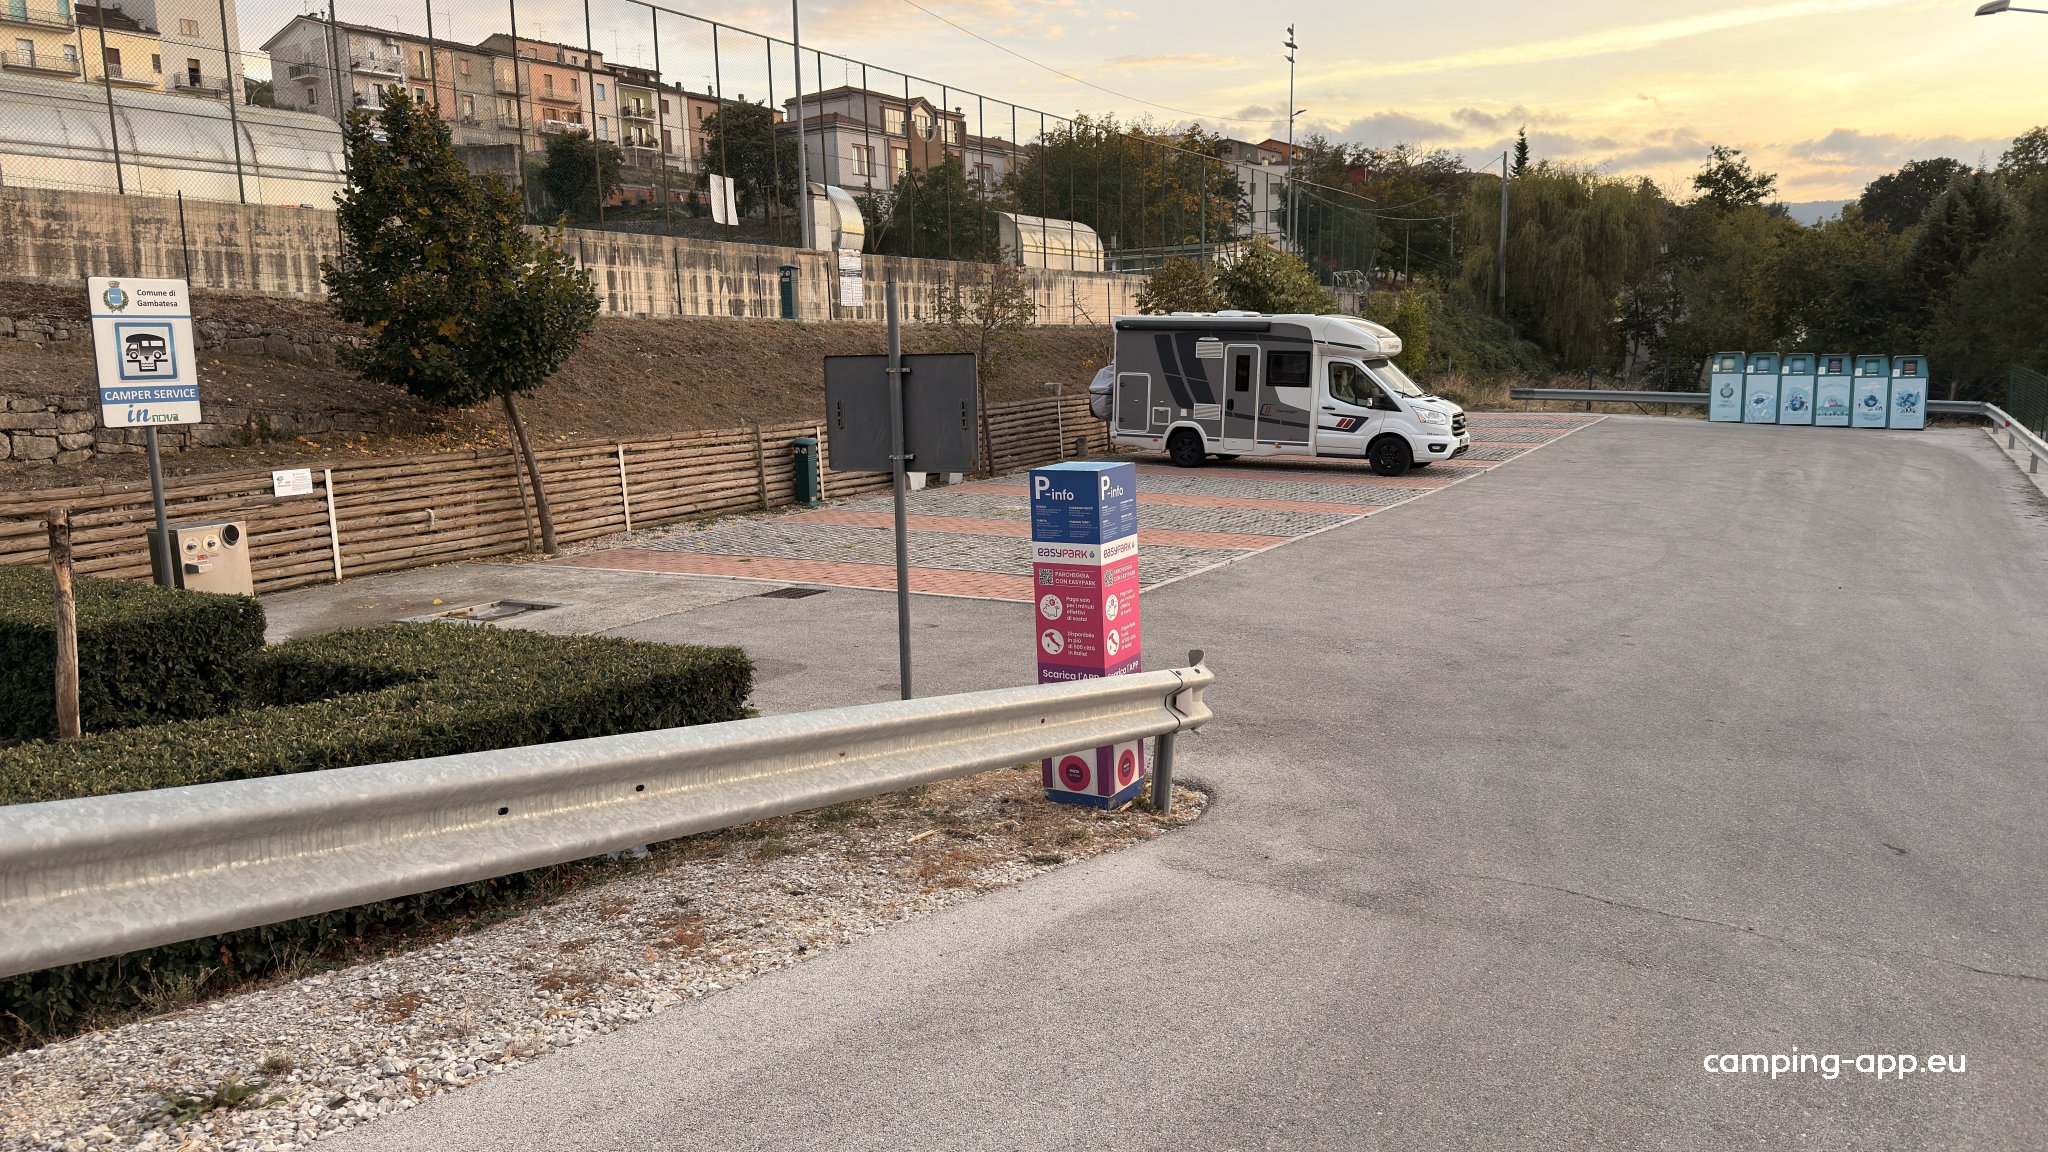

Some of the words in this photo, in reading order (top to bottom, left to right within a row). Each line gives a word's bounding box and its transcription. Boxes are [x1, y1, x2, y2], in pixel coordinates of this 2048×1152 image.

[136, 289, 167, 297] Comune
[168, 289, 176, 297] di
[136, 299, 178, 307] Gambatesa
[104, 390, 152, 401] CAMPER
[154, 388, 196, 399] SERVICE
[1034, 475, 1075, 501] P-info
[1100, 475, 1124, 501] P-info
[1054, 571, 1090, 579] PARCHEGGIA
[1042, 669, 1077, 680] Scarica
